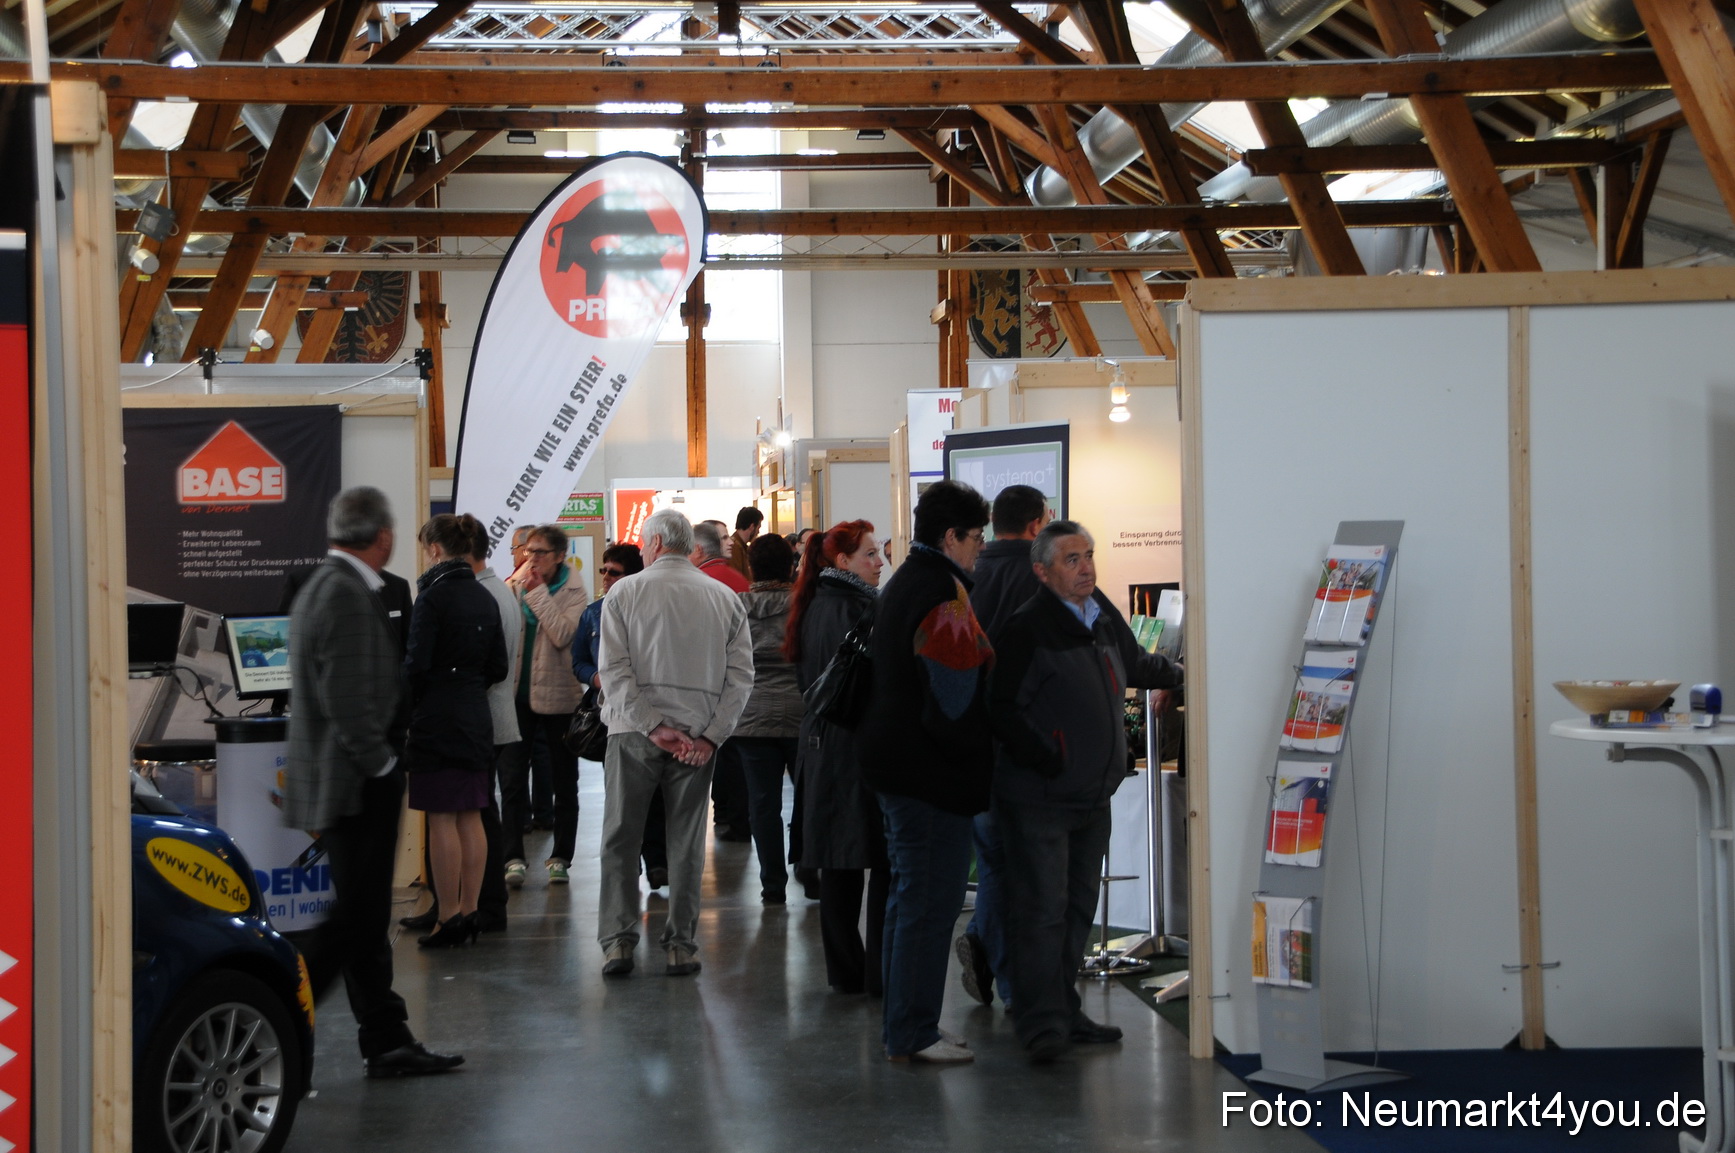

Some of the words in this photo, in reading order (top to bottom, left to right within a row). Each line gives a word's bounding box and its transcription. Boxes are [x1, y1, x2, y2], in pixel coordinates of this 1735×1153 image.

[563, 373, 627, 472] www.prefa.de
[506, 462, 543, 512] STARK
[533, 431, 561, 463] WIE
[552, 403, 578, 433] EIN
[569, 355, 607, 404] STIER!
[182, 466, 283, 497] BASE
[183, 530, 199, 538] Mehr
[201, 529, 243, 538] Wohnqualität
[1120, 531, 1163, 539] Einsparung
[183, 540, 220, 548] Erweiterter
[221, 539, 262, 548] Lebensraum
[183, 550, 206, 558] schnell
[207, 549, 243, 559] aufgestellt
[183, 560, 214, 568] perfekter
[215, 559, 237, 567] Schutz
[251, 558, 292, 567] Druckwasser
[293, 557, 304, 566] als
[183, 570, 200, 578] ohne
[201, 569, 242, 579] Verzögerung
[243, 569, 284, 577] weiterbauen
[151, 846, 247, 906] www.ZWS.de
